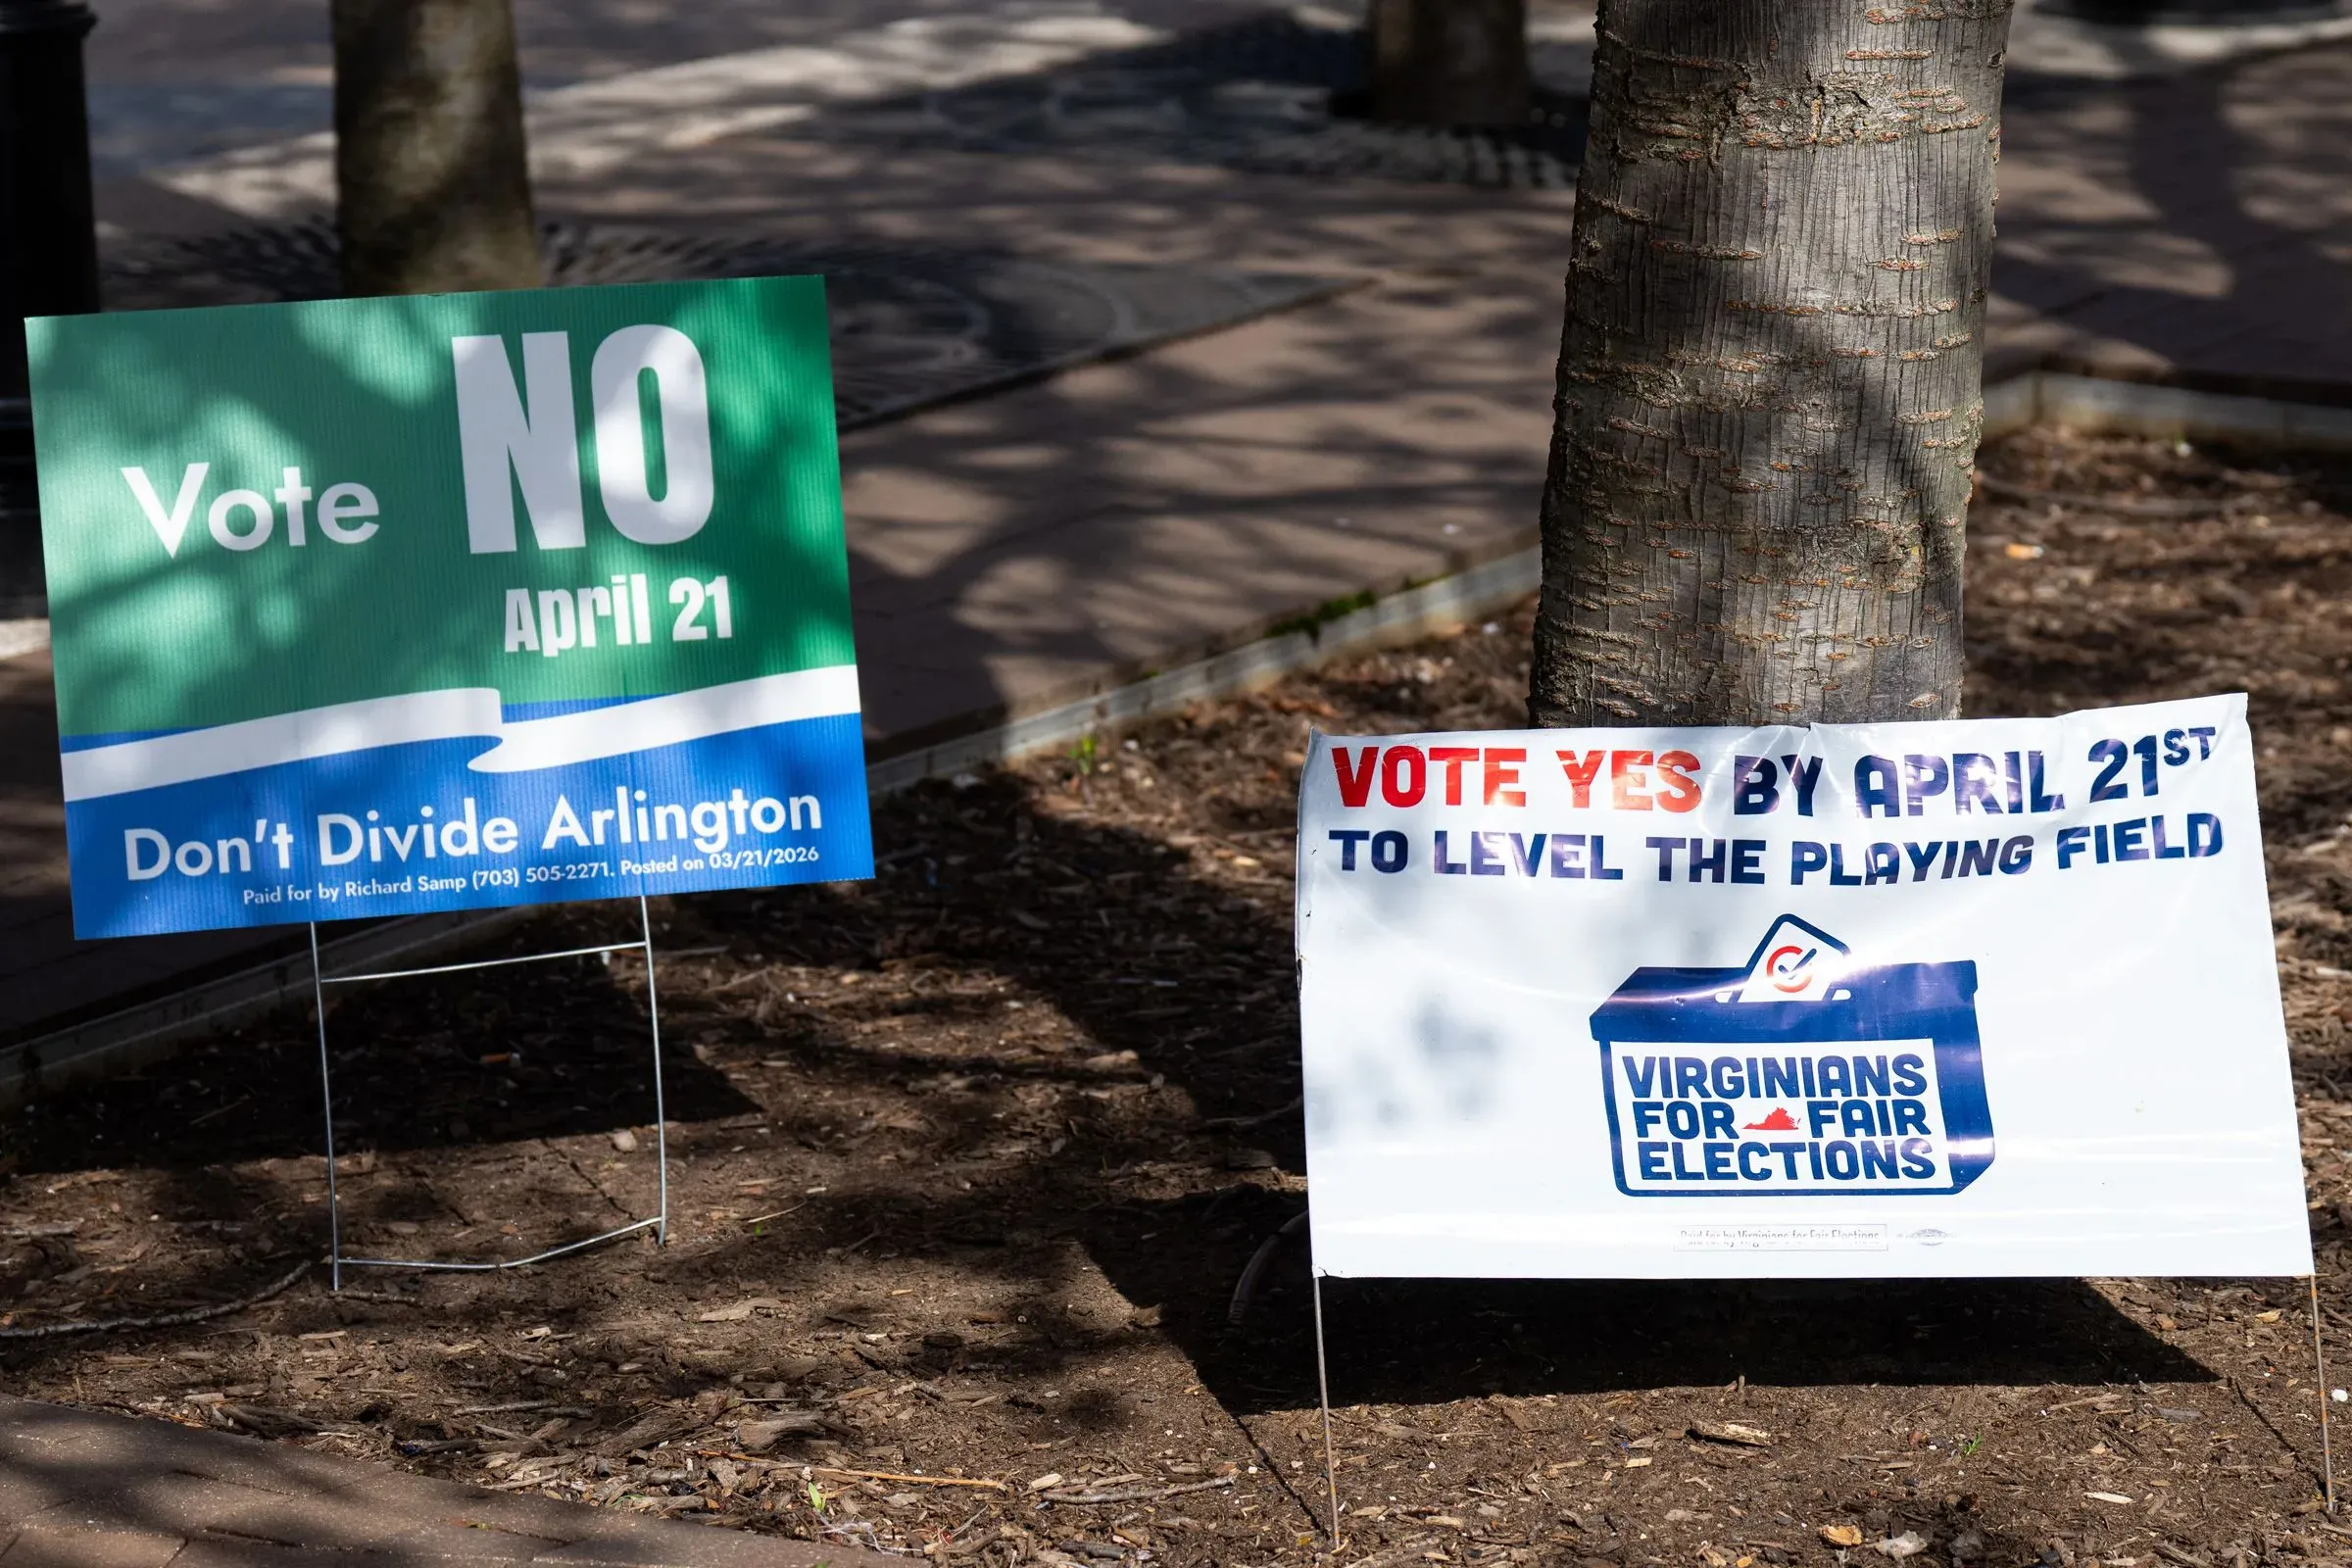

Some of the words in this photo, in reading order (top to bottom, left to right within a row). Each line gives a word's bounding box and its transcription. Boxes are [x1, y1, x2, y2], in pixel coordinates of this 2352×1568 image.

[122, 463, 379, 559] Vote
[452, 324, 714, 555] NO
[504, 572, 652, 657] April
[668, 575, 733, 642] 21
[1331, 745, 1527, 808] VOTE
[1555, 749, 1702, 812] YES
[1733, 755, 1824, 817] BY
[1853, 750, 2065, 819] APRIL
[2088, 726, 2217, 803] 21ST
[123, 818, 293, 880] Don't
[318, 797, 518, 866] Divide
[541, 786, 822, 854] Arlington
[1328, 830, 1408, 873] TO
[1434, 830, 1623, 880] LEVEL
[1645, 836, 1766, 884] THE
[1790, 834, 2034, 886] PLAYING
[2058, 812, 2224, 869] FIELD
[243, 886, 280, 905] Paid
[287, 884, 312, 901] for
[318, 882, 339, 903] by
[345, 876, 412, 897] Richard
[417, 875, 466, 894] Samp
[472, 869, 519, 891] (703)
[525, 861, 614, 883] 505-2271.
[620, 855, 677, 876] Posted
[683, 859, 705, 871] on
[709, 846, 819, 870] 03/21/2026
[1622, 1054, 1928, 1100] VIRGINIANS
[1632, 1101, 1740, 1139] FOR
[1807, 1099, 1931, 1138] FAIR
[1638, 1139, 1936, 1181] ELECTIONS
